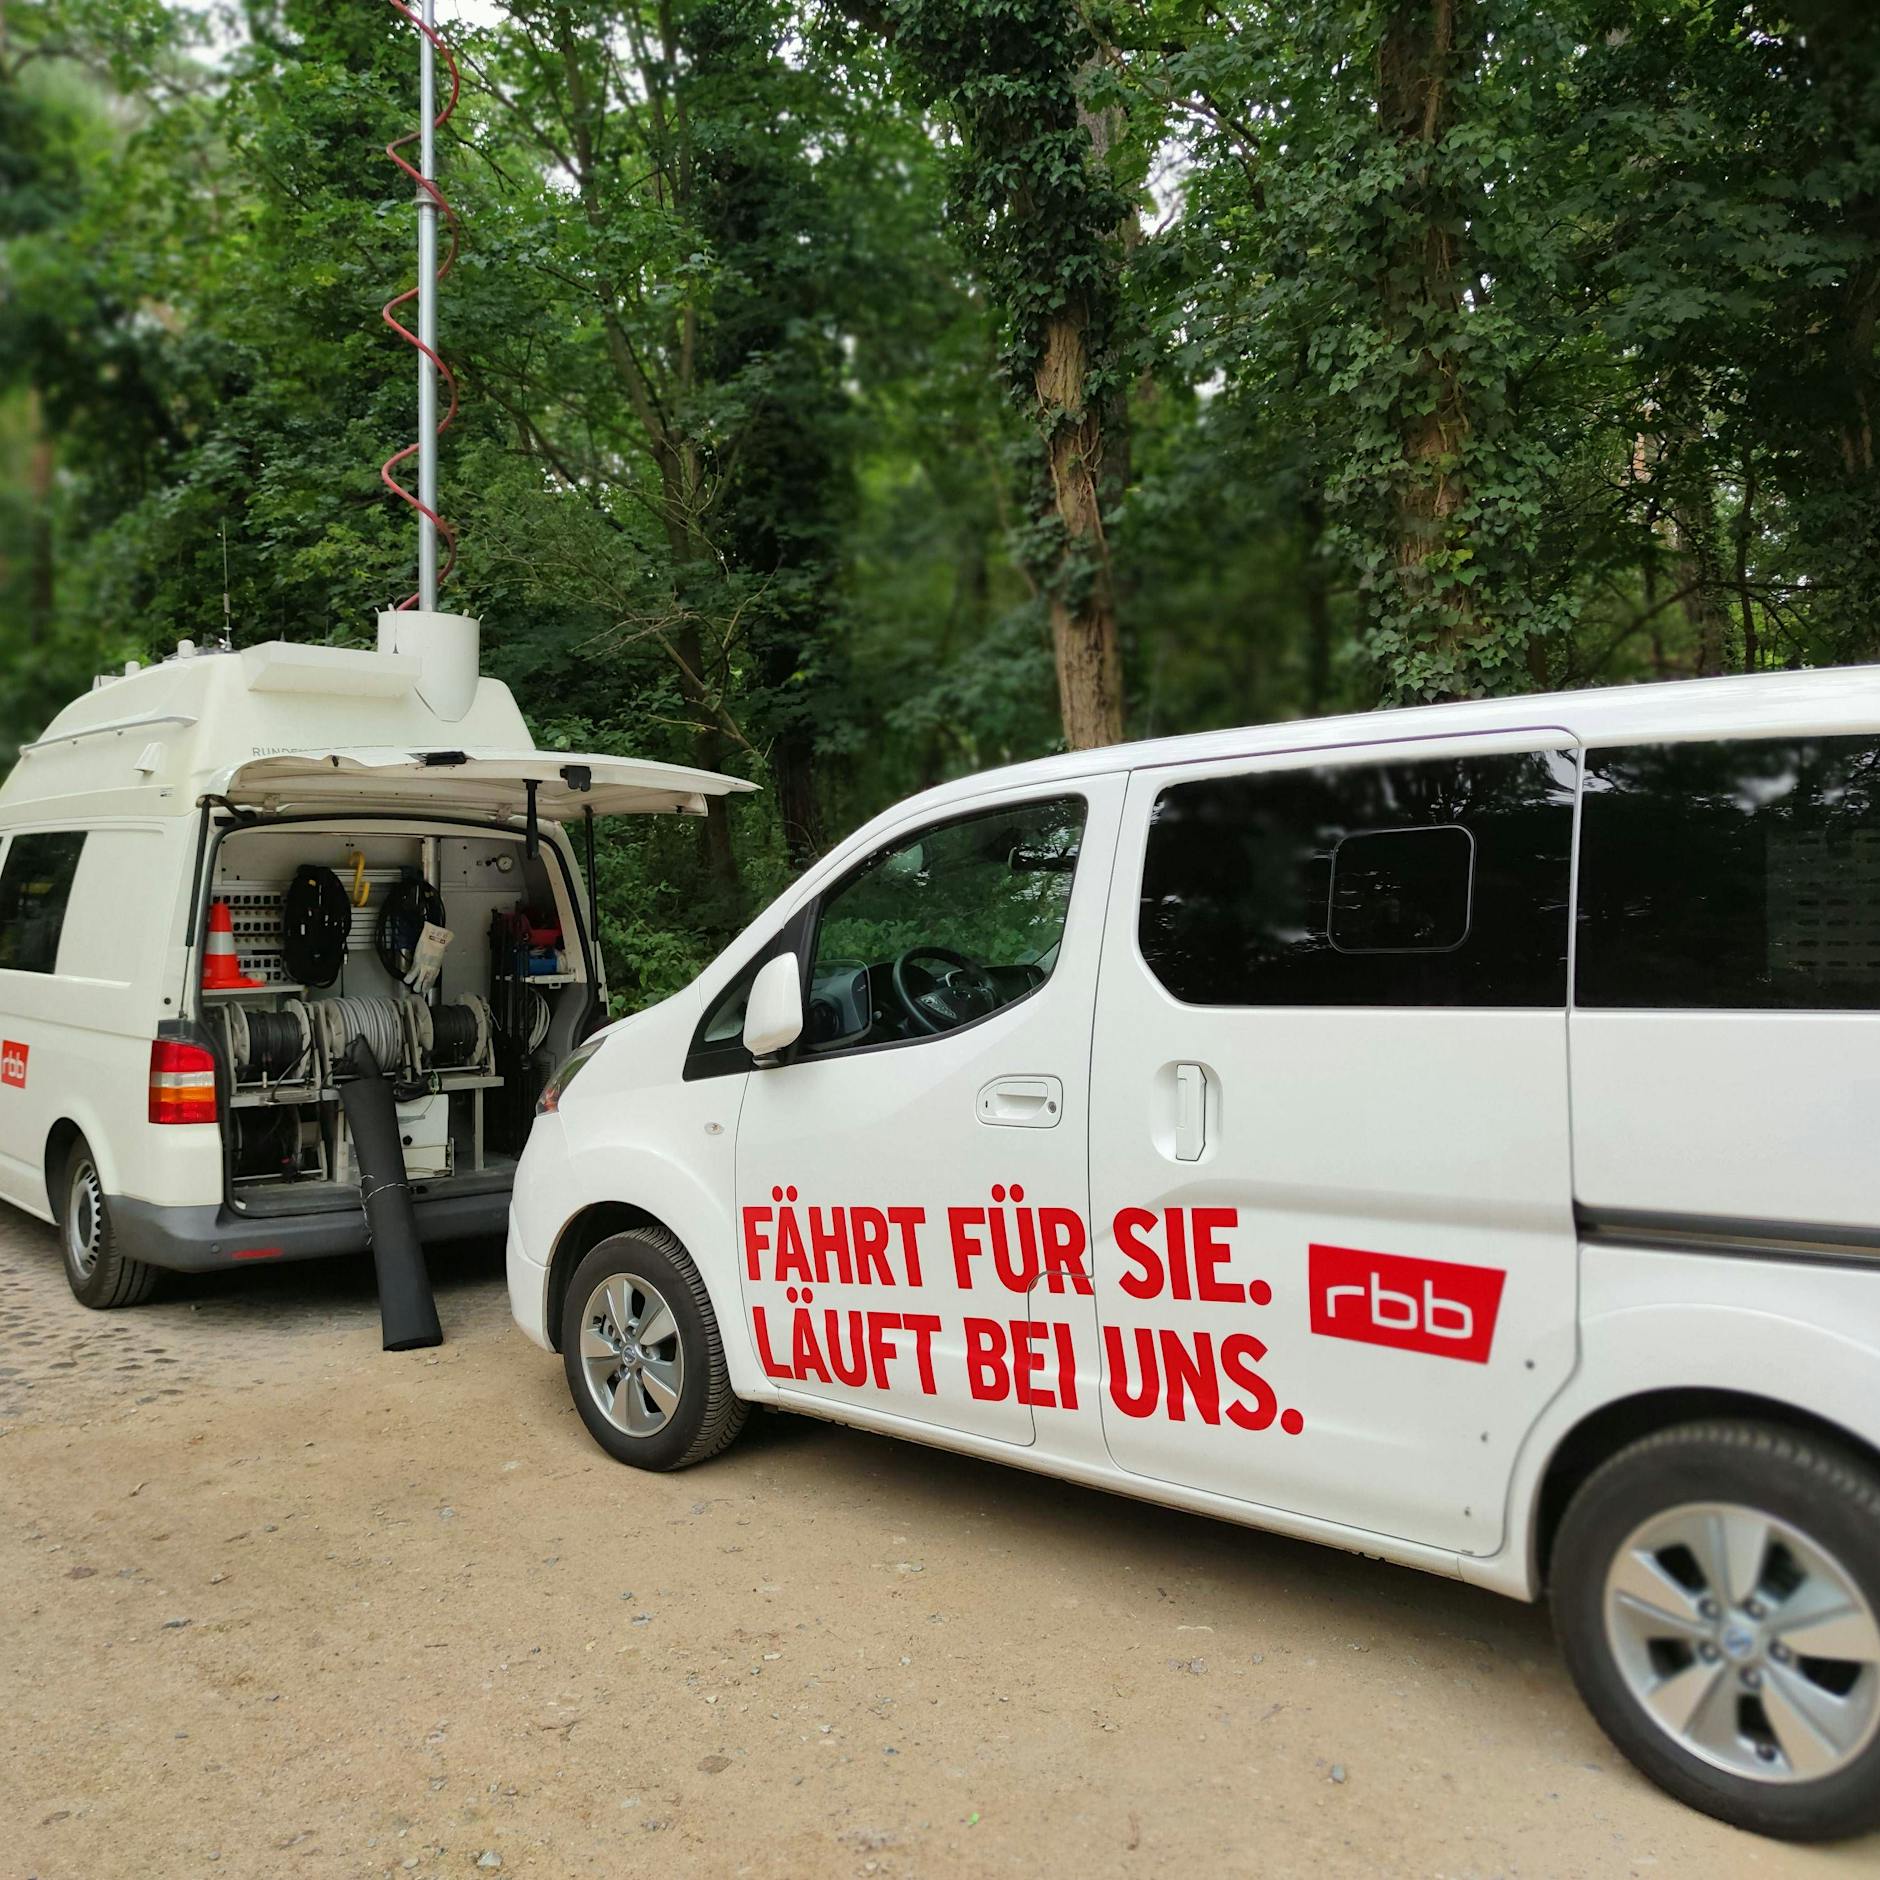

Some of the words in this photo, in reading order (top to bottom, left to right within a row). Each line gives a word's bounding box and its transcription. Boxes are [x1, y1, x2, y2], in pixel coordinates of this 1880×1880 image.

[742, 1184, 926, 1290] FÄHRT
[947, 1184, 1094, 1296] FÜR
[1113, 1207, 1272, 1306] SIE.
[1327, 1273, 1472, 1338] rbb
[752, 1286, 942, 1395] LÄUFT
[963, 1317, 1078, 1410] BEI
[1103, 1326, 1304, 1435] UNS.
